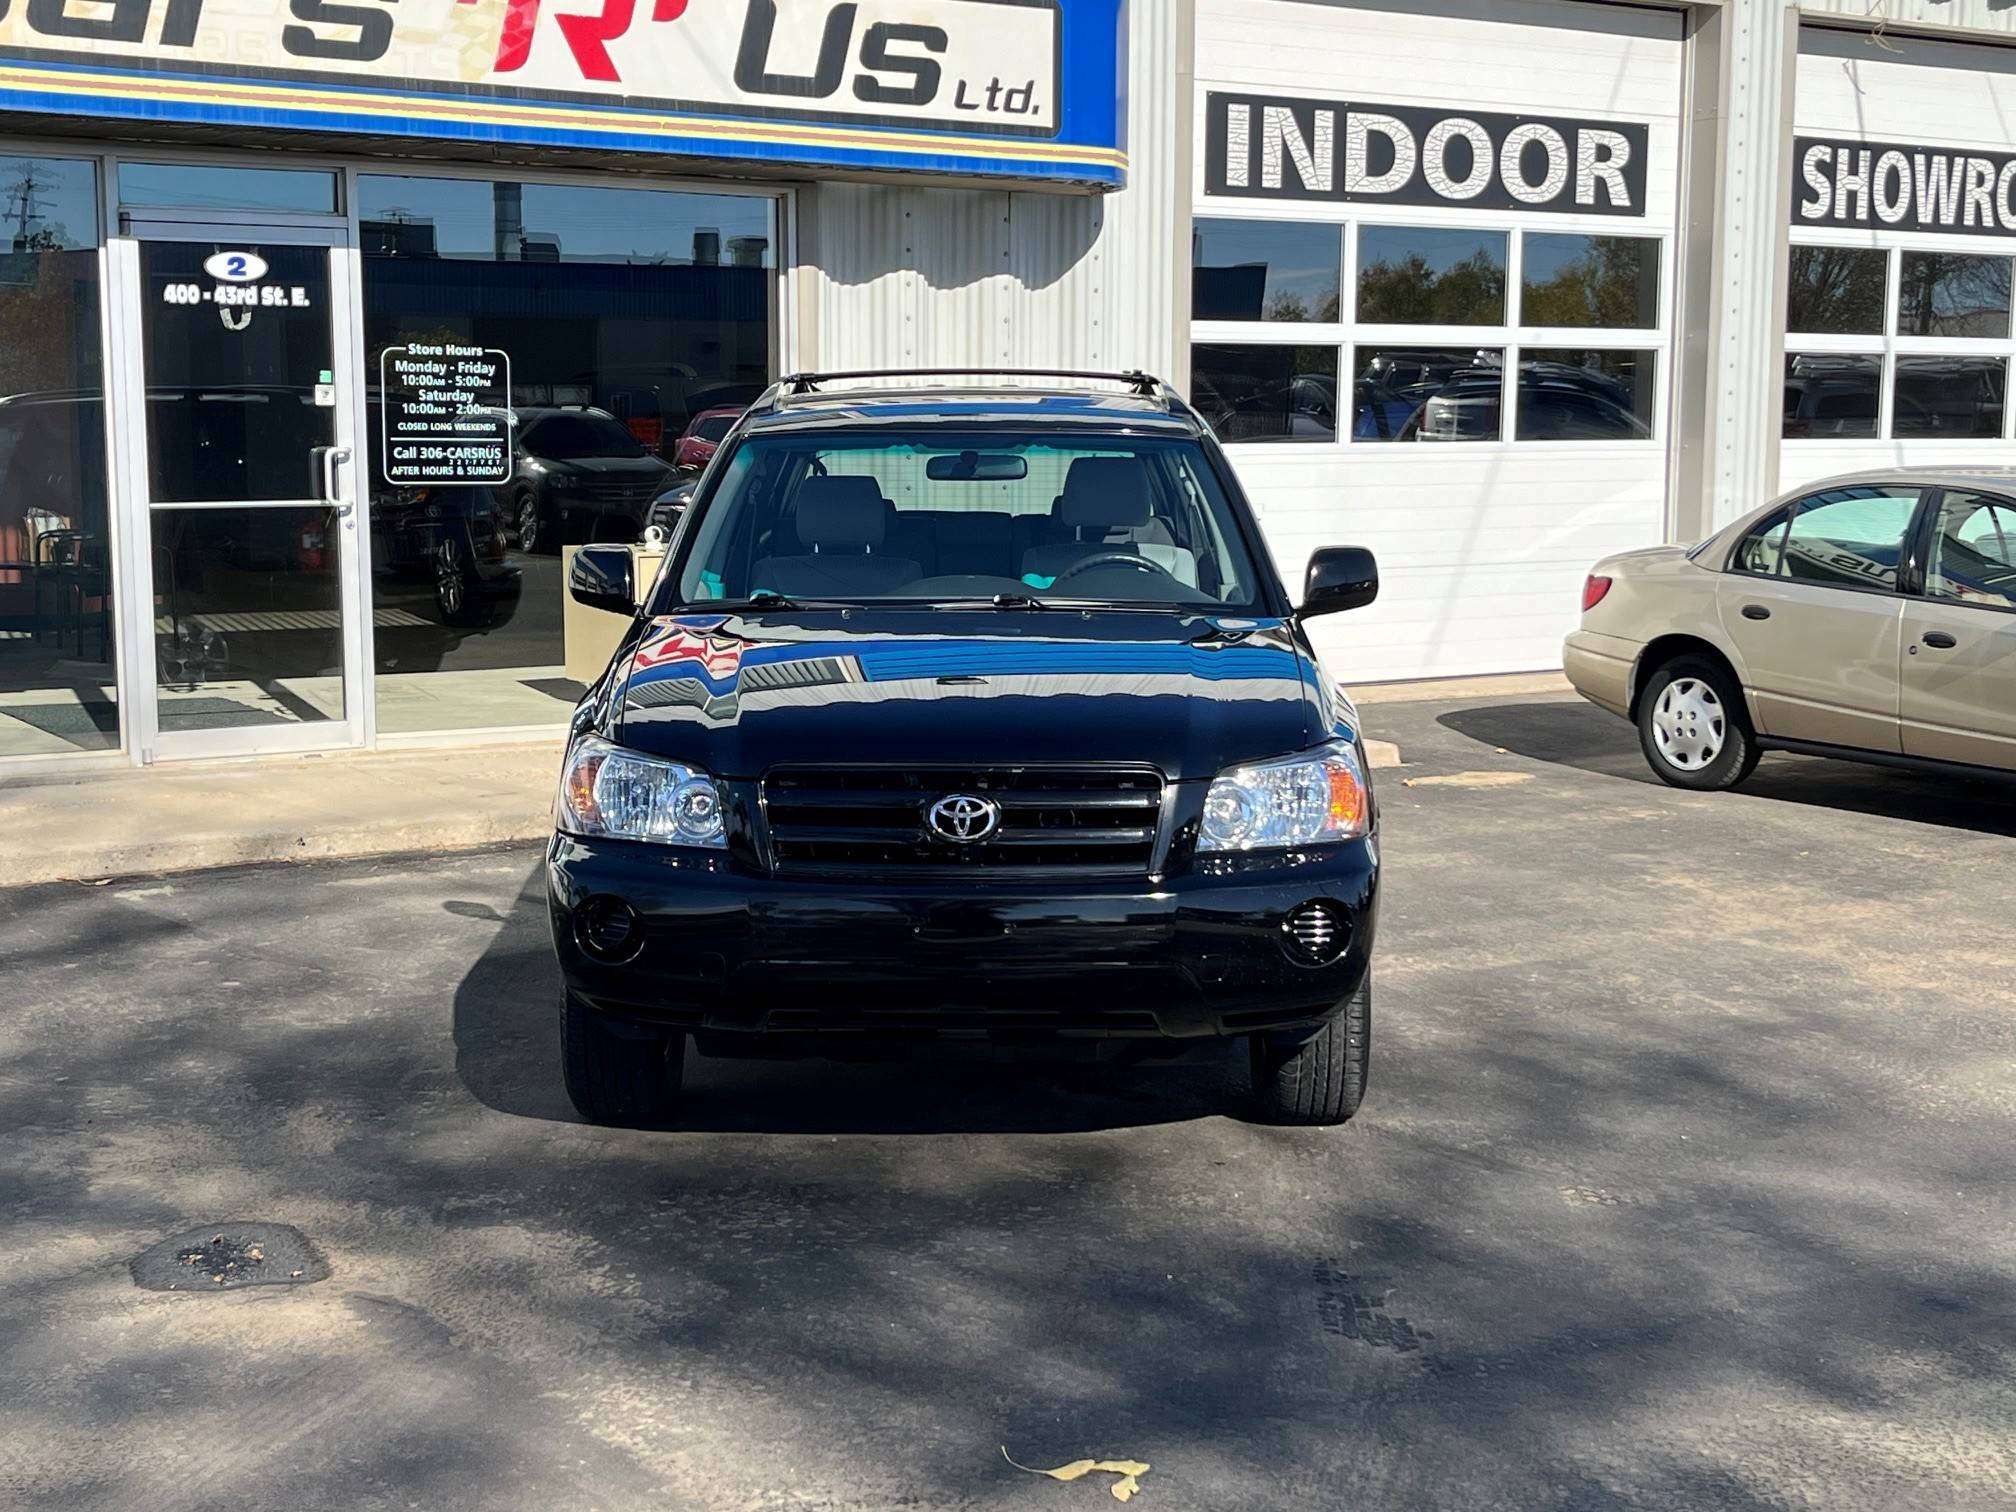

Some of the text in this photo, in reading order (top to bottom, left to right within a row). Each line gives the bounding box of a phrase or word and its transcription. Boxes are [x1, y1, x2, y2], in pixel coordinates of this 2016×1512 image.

[733, 0, 949, 105] Us
[954, 77, 1040, 115] Ltd.
[1225, 102, 1632, 207] INDOOR
[227, 256, 247, 276] 2
[163, 284, 200, 304] 400
[213, 284, 259, 305] 43rd
[260, 286, 289, 306] St.
[290, 286, 311, 307] E.
[407, 343, 484, 357] Store Hours
[394, 360, 447, 376] Monday
[457, 361, 496, 377] Friday
[418, 389, 475, 404] Saturday
[397, 421, 497, 432] CLOSED LONG WEEKENDS
[393, 446, 502, 460] Call 306-CARSRUS
[390, 466, 505, 477] AFTER HOURS & SUNDAY
